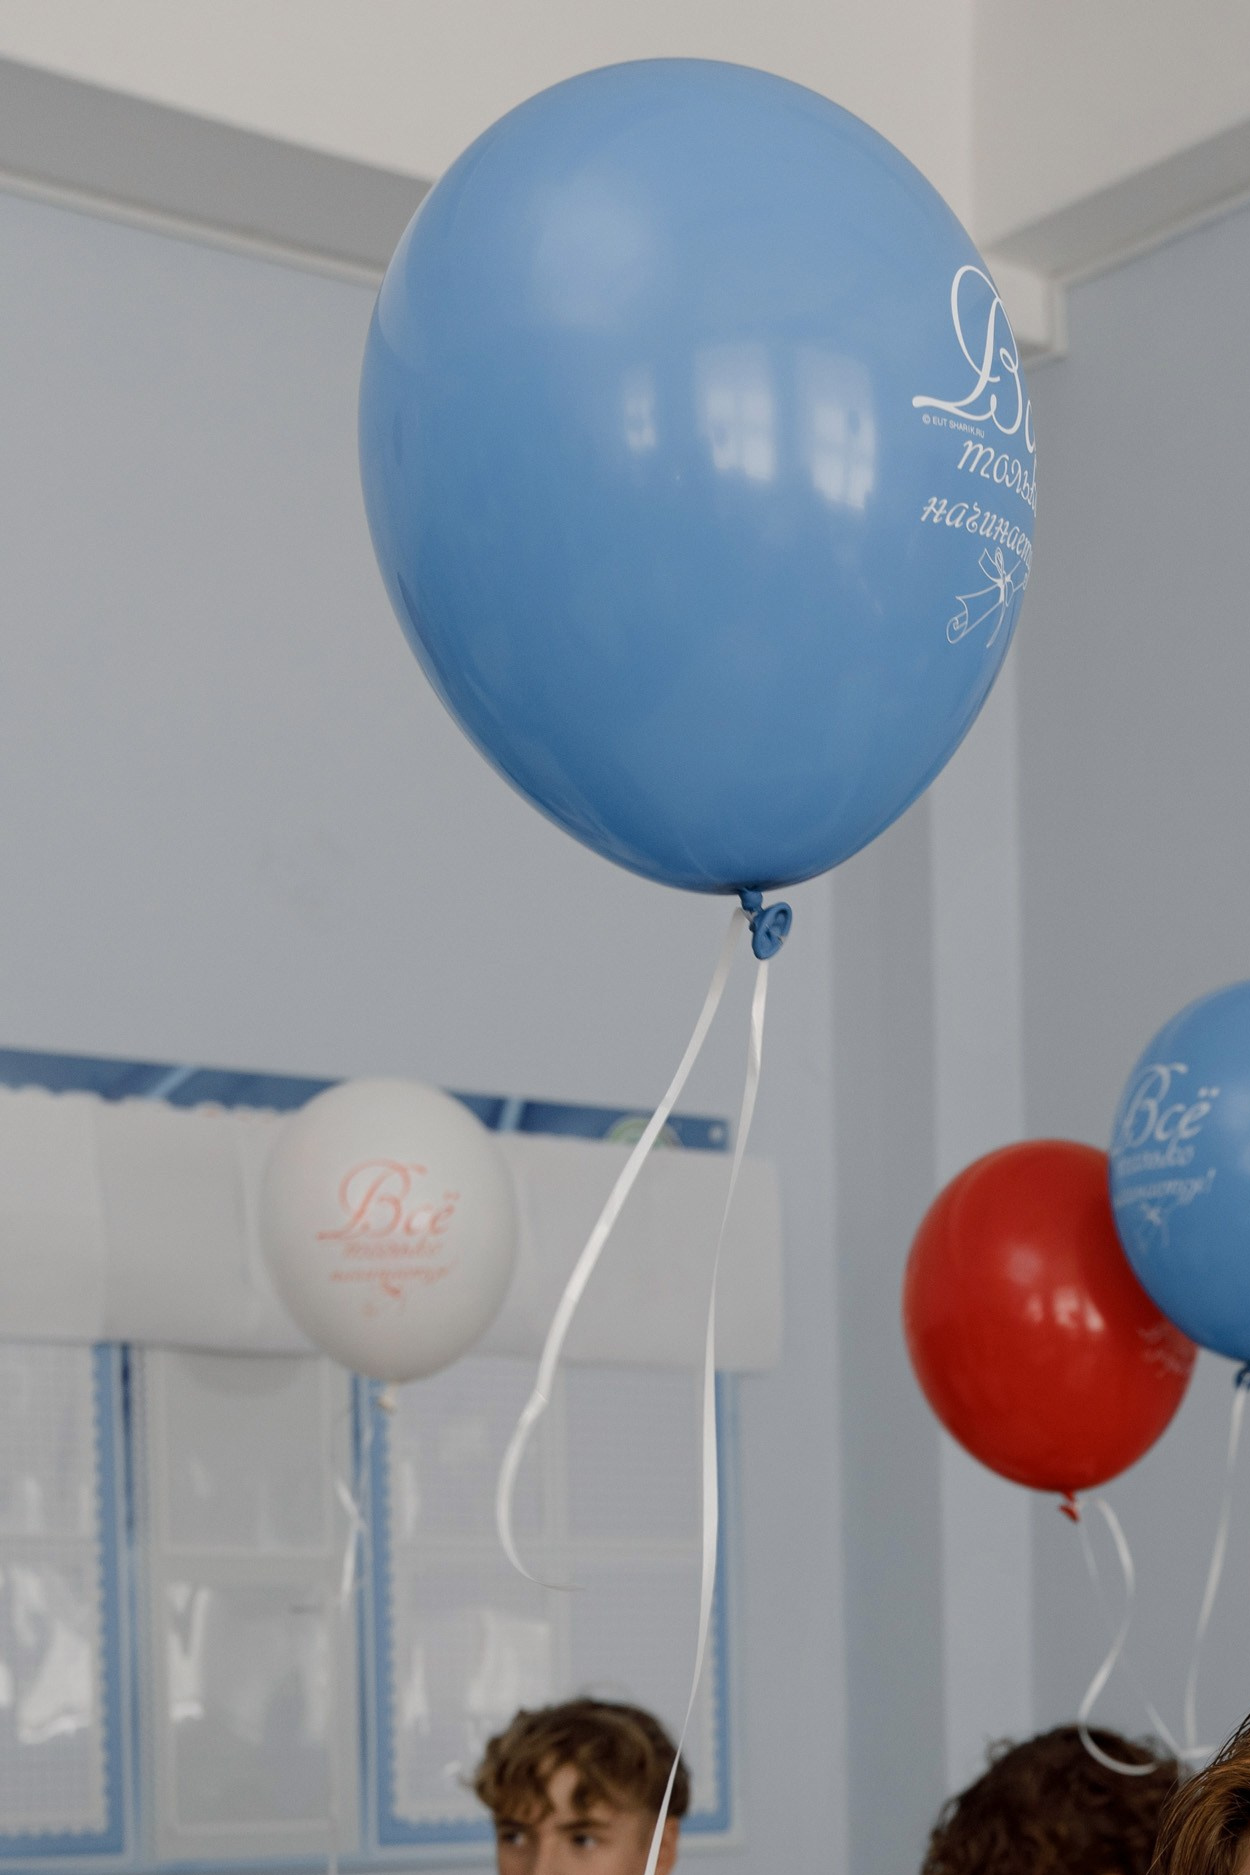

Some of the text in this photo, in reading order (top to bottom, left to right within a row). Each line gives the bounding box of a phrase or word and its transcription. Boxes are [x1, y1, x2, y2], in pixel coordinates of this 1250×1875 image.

[949, 420, 985, 439] SHARIK.RU
[1111, 1062, 1221, 1154] Всё
[316, 1158, 460, 1242] Всё
